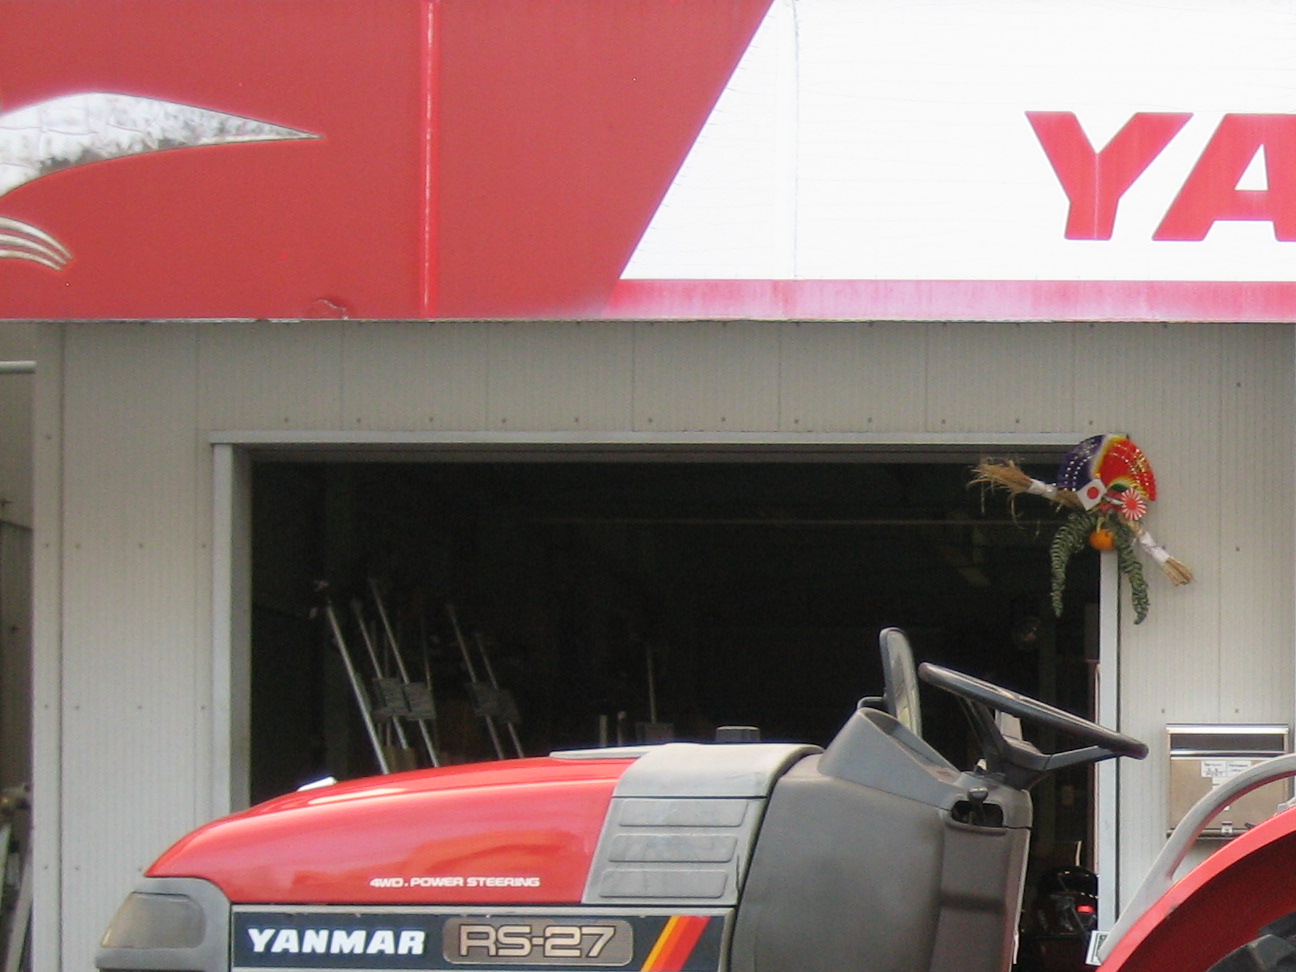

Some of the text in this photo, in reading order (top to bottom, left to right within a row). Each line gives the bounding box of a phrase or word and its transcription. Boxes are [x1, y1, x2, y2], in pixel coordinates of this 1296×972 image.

[410, 877, 464, 888] POWER
[466, 877, 541, 888] STEERING
[247, 924, 616, 958] YANMAR RS-27
